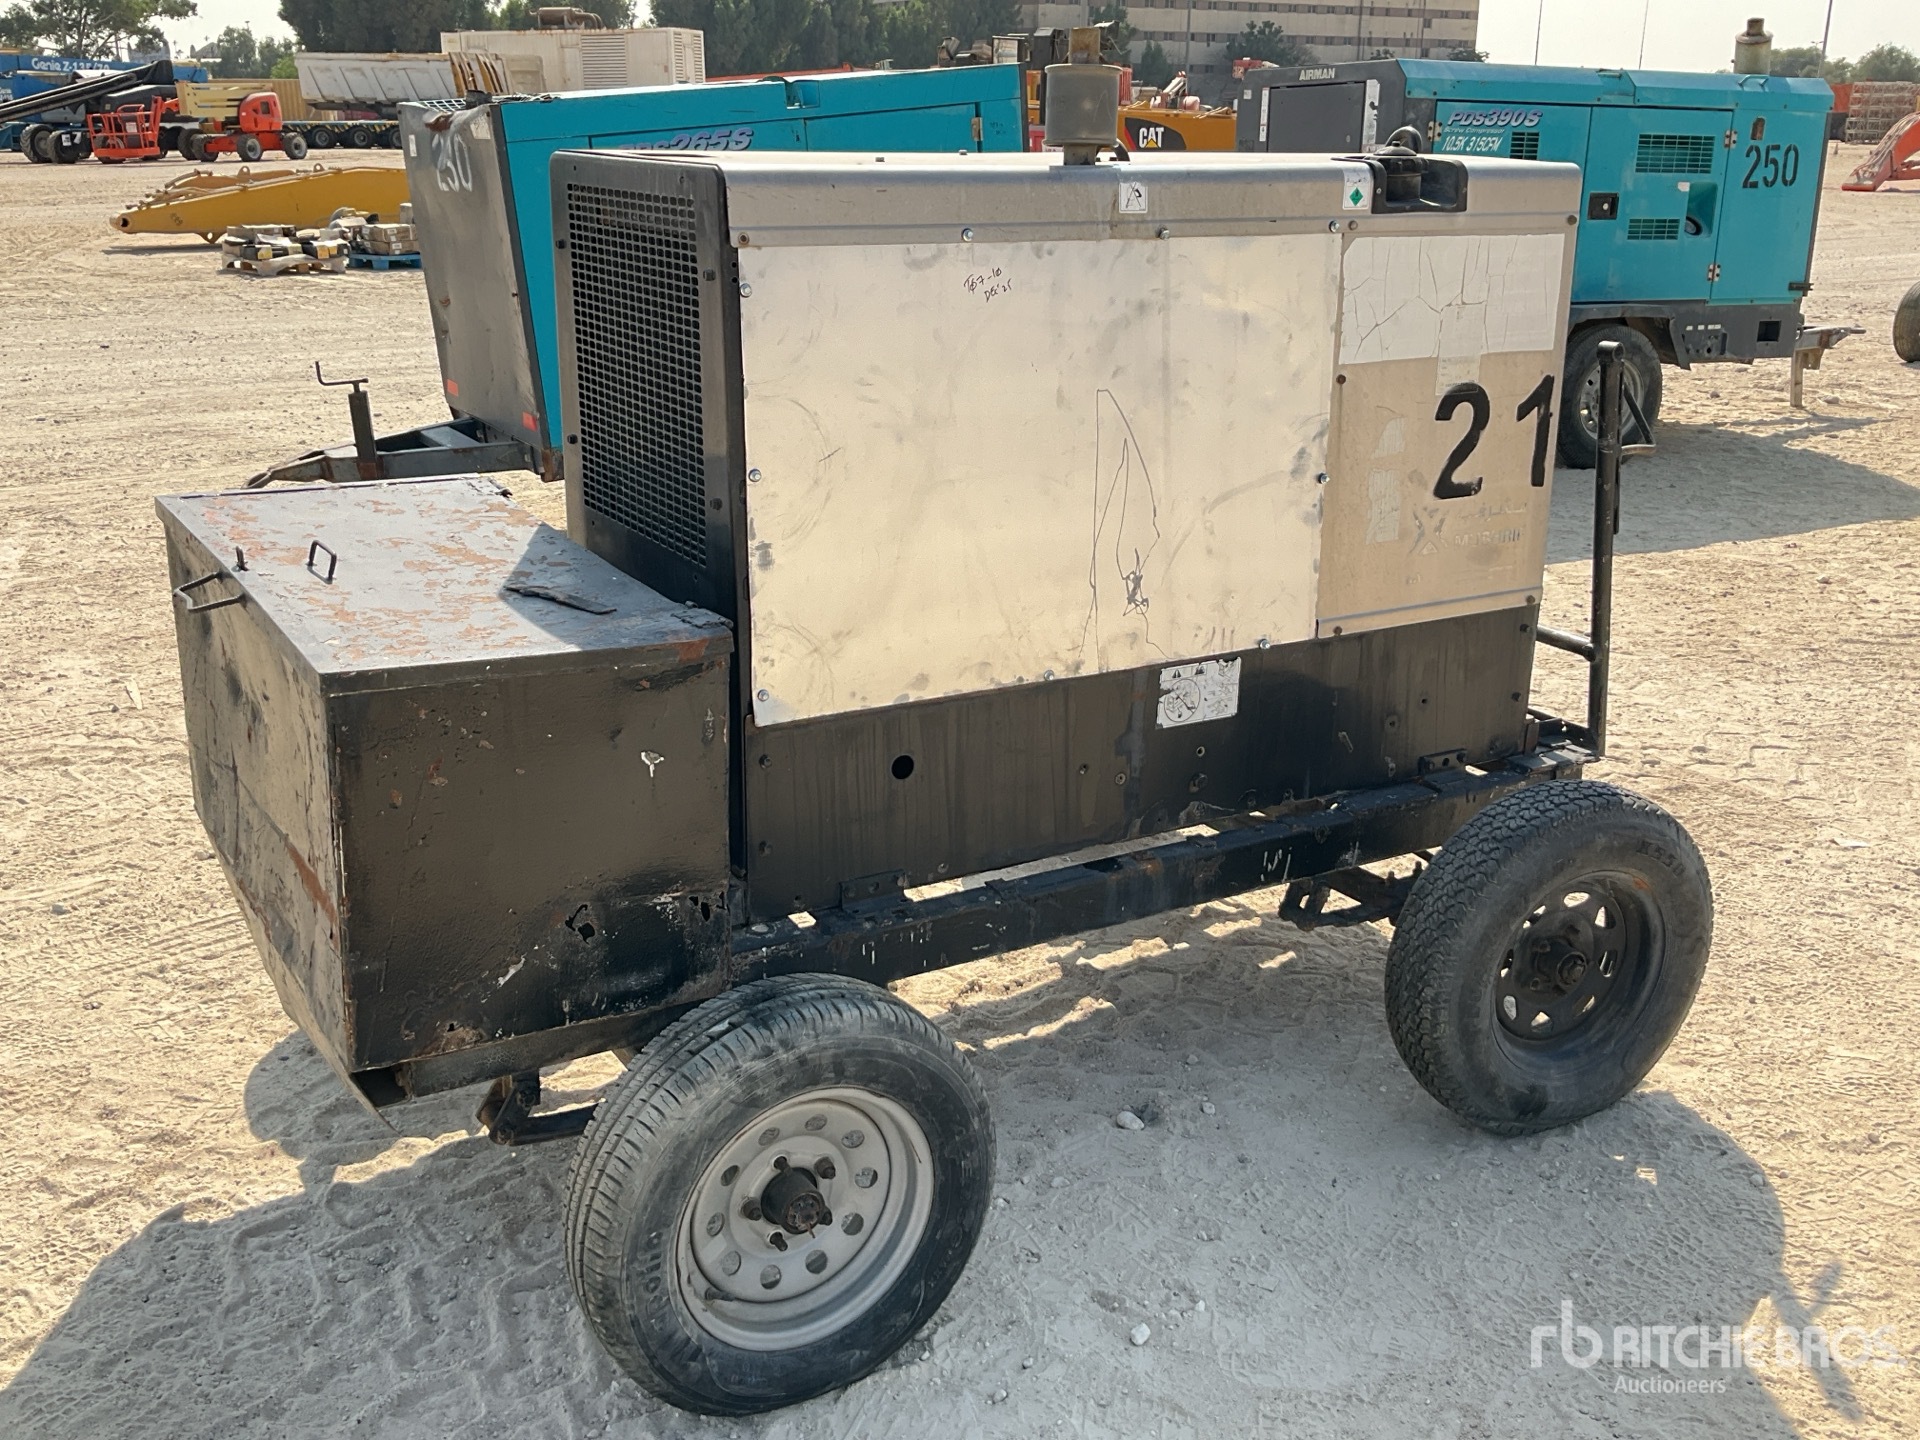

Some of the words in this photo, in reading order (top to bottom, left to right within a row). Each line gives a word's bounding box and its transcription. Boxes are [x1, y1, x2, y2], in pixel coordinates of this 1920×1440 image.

[31, 57, 62, 71] Genie
[1299, 68, 1336, 80] AIRMAN
[1447, 107, 1544, 128] PDS390S
[1139, 126, 1165, 149] CAT
[1443, 126, 1466, 134] Screw
[1466, 127, 1506, 135] Compressor
[1466, 136, 1504, 153] 315CFM
[1742, 143, 1800, 190] 250
[1433, 374, 1555, 499] 21
